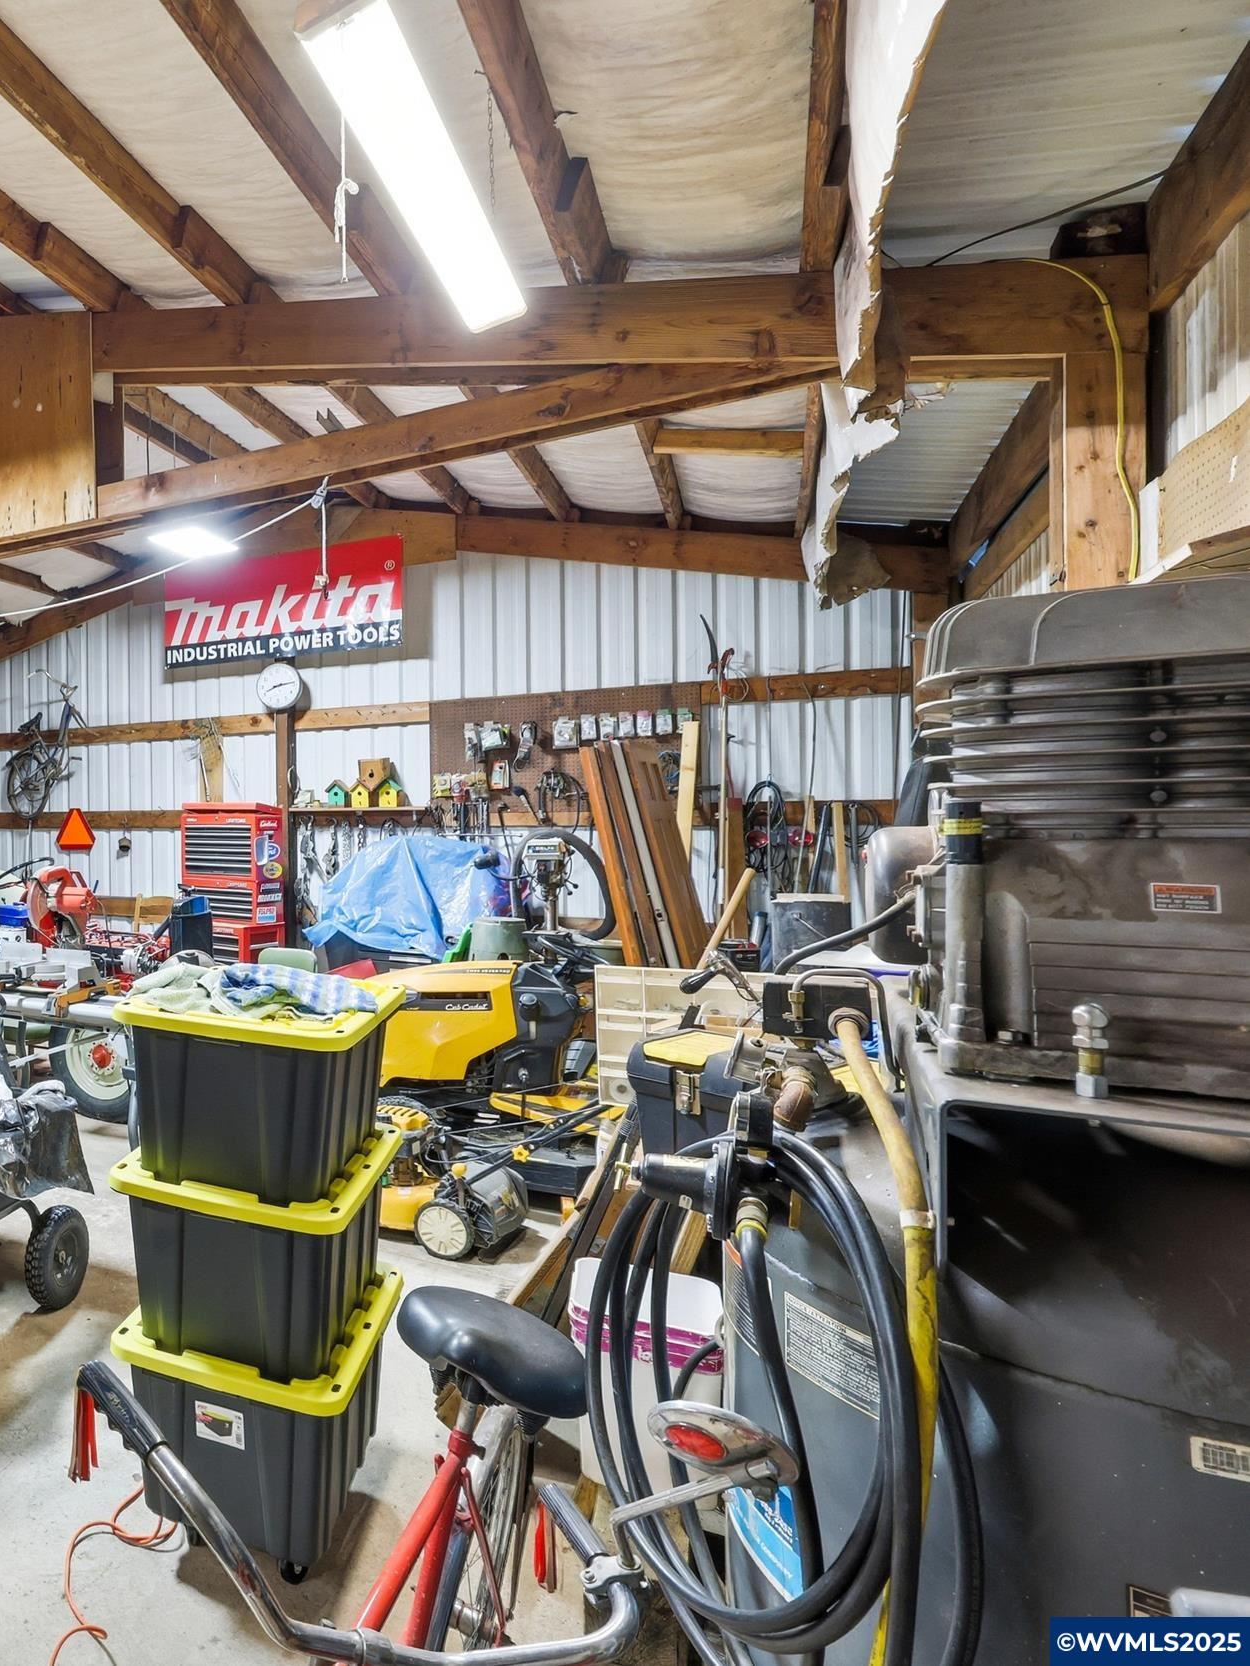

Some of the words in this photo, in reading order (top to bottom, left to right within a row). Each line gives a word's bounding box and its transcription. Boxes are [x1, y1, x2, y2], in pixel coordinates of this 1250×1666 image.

[166, 639, 266, 665] INDUSTRIAL
[268, 632, 334, 656] POWER
[336, 624, 401, 646] TOOLS
[445, 1003, 461, 1011] Cub
[461, 1003, 489, 1011] Cadet
